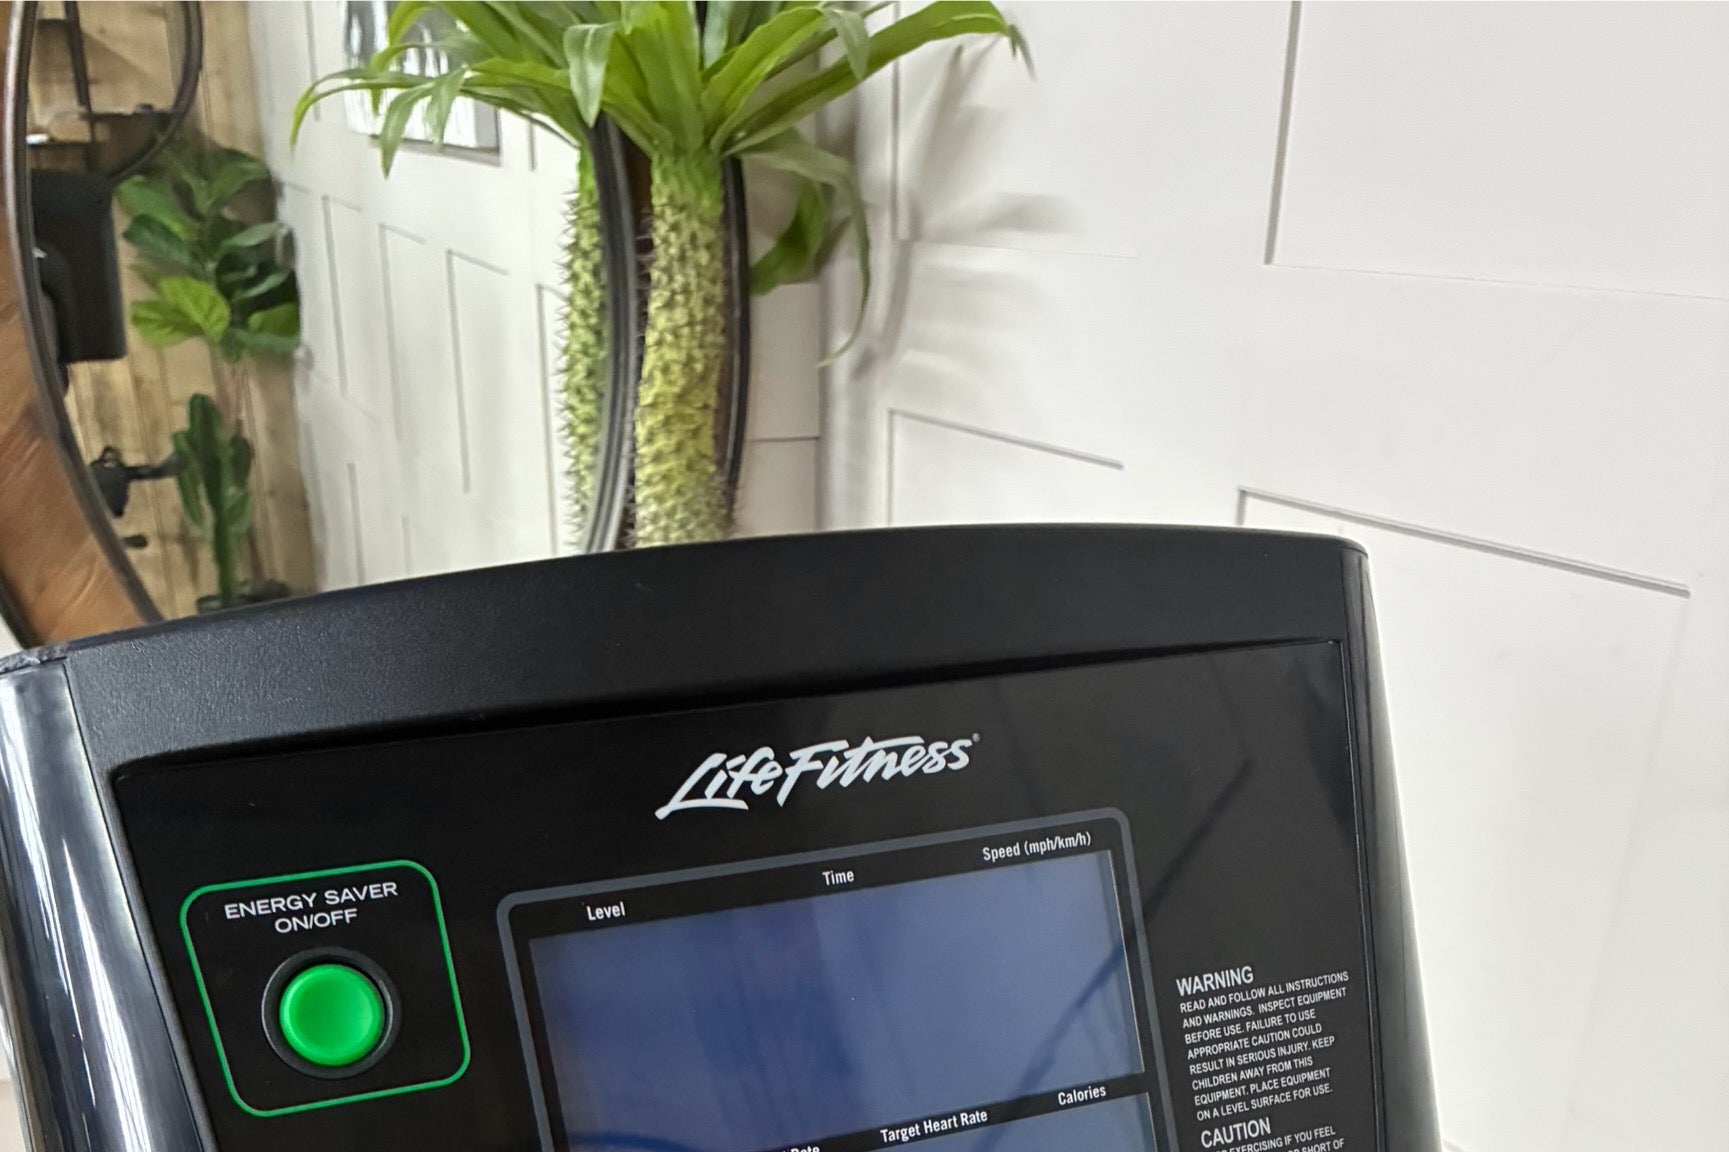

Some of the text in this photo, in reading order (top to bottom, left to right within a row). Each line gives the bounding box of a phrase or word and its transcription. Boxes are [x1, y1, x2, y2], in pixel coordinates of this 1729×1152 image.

[982, 831, 1091, 863] Speed (mph/km/h)
[822, 870, 855, 886] Time
[224, 881, 398, 920] ENERGY SAVER
[586, 901, 626, 921] Level
[274, 908, 358, 934] ON/OFF
[1175, 965, 1254, 997] WARNING
[1179, 970, 1349, 1014] READ AND FOLLOW ALL INSTRUCTIONS
[1182, 1015, 1203, 1029] AND
[1257, 996, 1295, 1014] INSPECT
[1296, 986, 1347, 1006] EQUIPMENT
[1184, 1027, 1223, 1045] BEFORE
[1245, 1014, 1284, 1032] FAILURE
[1283, 1012, 1297, 1024] TO
[1297, 1008, 1317, 1022] USE
[1187, 1022, 1323, 1060] APPROPRIATE CAUTION COULD
[1189, 1058, 1224, 1075] RESULT
[1225, 1056, 1236, 1068] IN
[1236, 1047, 1277, 1066] SERIOUS
[1311, 1035, 1335, 1050] KEEP
[1191, 1055, 1314, 1091] CHILDREN AWAY FROM THIS
[1249, 1078, 1280, 1094] PLACE
[1280, 1066, 1330, 1088] EQUIPMENT
[1057, 1085, 1107, 1106] Calories
[1196, 1109, 1211, 1122] ON
[1212, 1107, 1220, 1118] A
[1220, 1101, 1250, 1117] LEVEL
[1250, 1091, 1292, 1110] SURFACE
[1292, 1086, 1312, 1100] FOR
[879, 1110, 988, 1143] Target Heart Rate
[1200, 1117, 1271, 1149] CAUTION
[1283, 1134, 1292, 1146] IF
[1293, 1130, 1313, 1144] YOU
[1313, 1125, 1336, 1139] FEEL
[1332, 1137, 1344, 1150] OF
